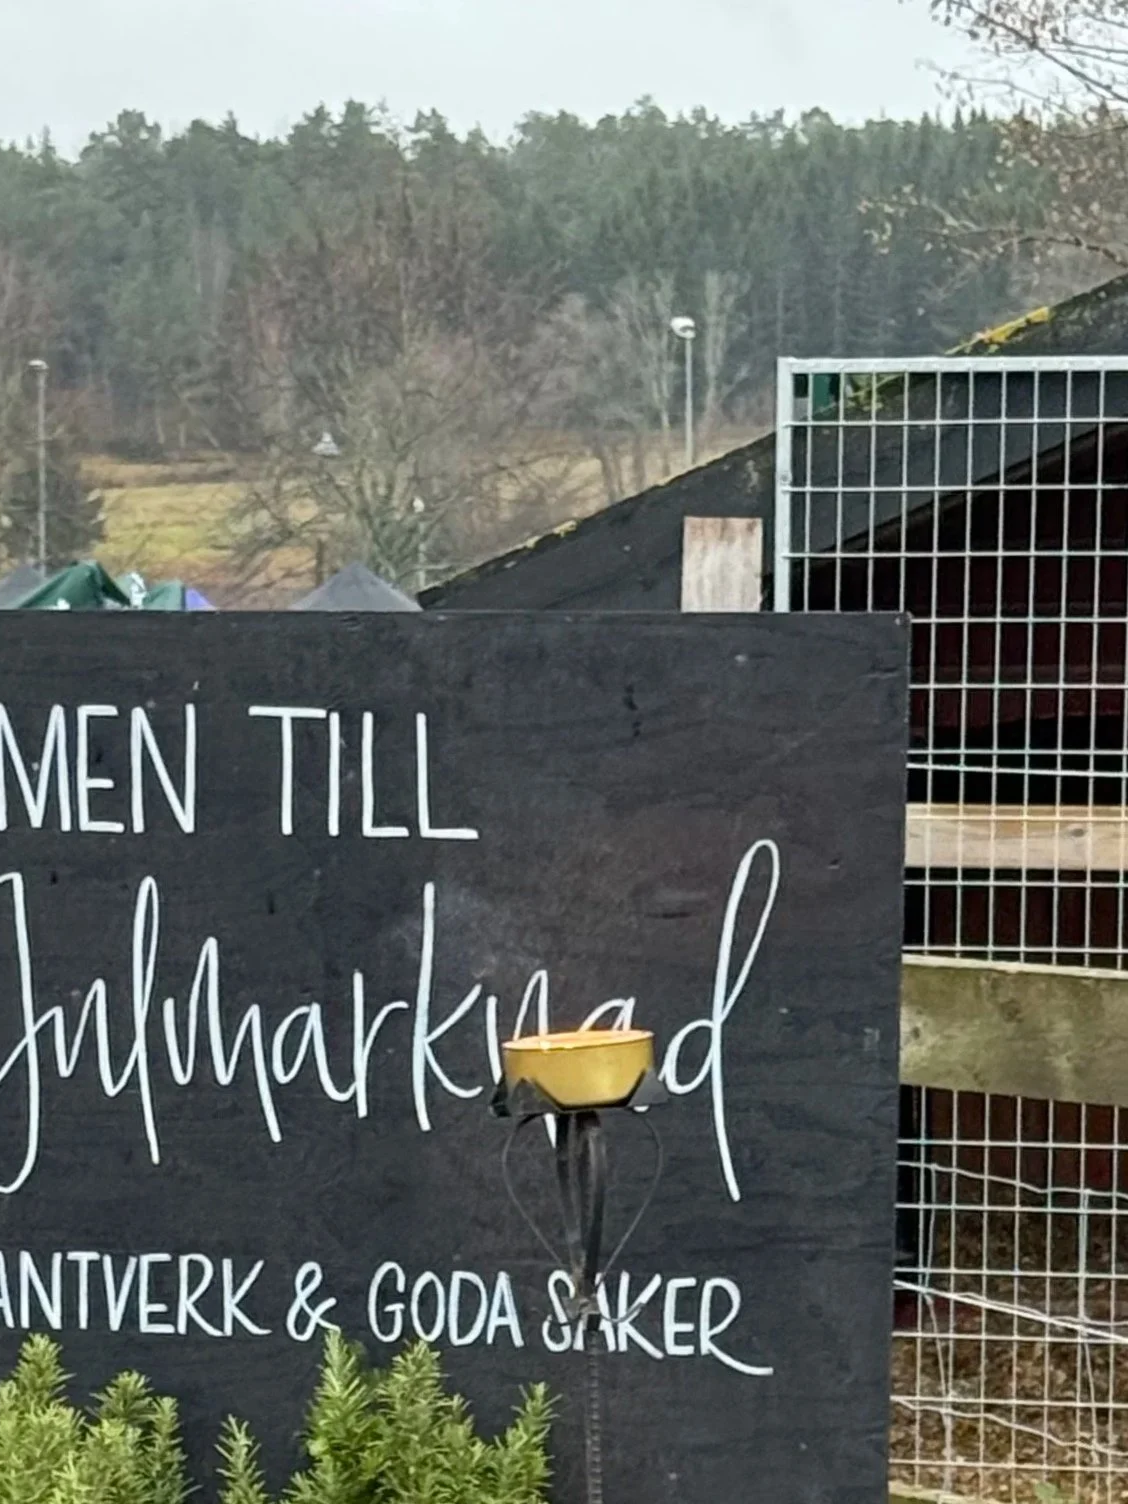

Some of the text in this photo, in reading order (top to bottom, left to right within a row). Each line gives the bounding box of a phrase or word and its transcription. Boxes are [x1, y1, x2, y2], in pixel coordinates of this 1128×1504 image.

[248, 705, 479, 840] TILL
[286, 1261, 341, 1342] &
[368, 1261, 524, 1353] GODA
